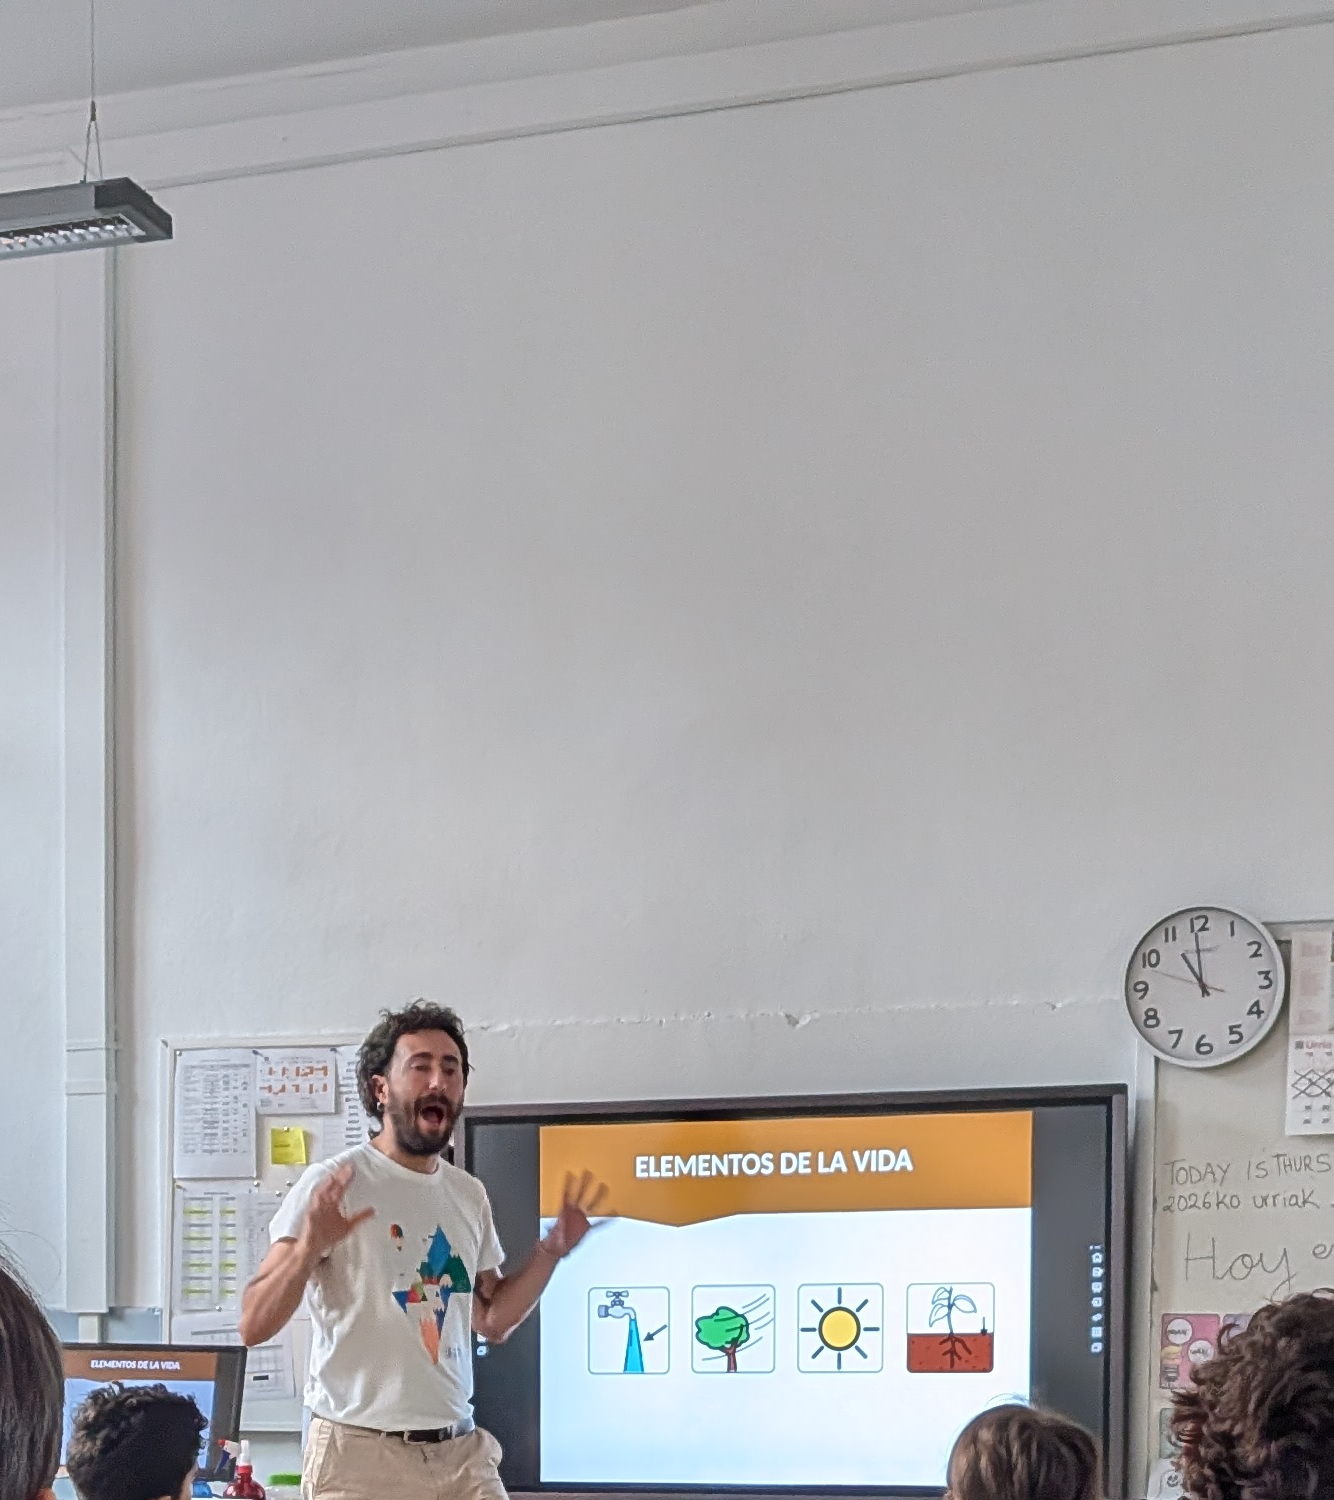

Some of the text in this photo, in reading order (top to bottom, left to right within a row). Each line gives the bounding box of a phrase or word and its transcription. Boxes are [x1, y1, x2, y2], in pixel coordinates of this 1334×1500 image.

[1163, 925, 1177, 943] 11
[1189, 914, 1210, 934] 12
[1141, 948, 1161, 969] 10
[1246, 940, 1263, 959] 2
[1133, 980, 1149, 1000] 9
[1257, 970, 1273, 990] 3
[1143, 1007, 1161, 1029] 8
[1246, 999, 1265, 1019] 4
[1167, 1028, 1184, 1049] 7
[1194, 1034, 1214, 1055] 6
[1228, 1023, 1244, 1045] 5
[635, 1148, 914, 1179] ELEMENTOS DE LA VIDA
[1163, 1158, 1231, 1187] TODAY
[1246, 1159, 1269, 1181] IS
[1184, 1231, 1298, 1302] Hoy
[90, 1360, 181, 1370] ELEMENTOS DE LA VIDA
